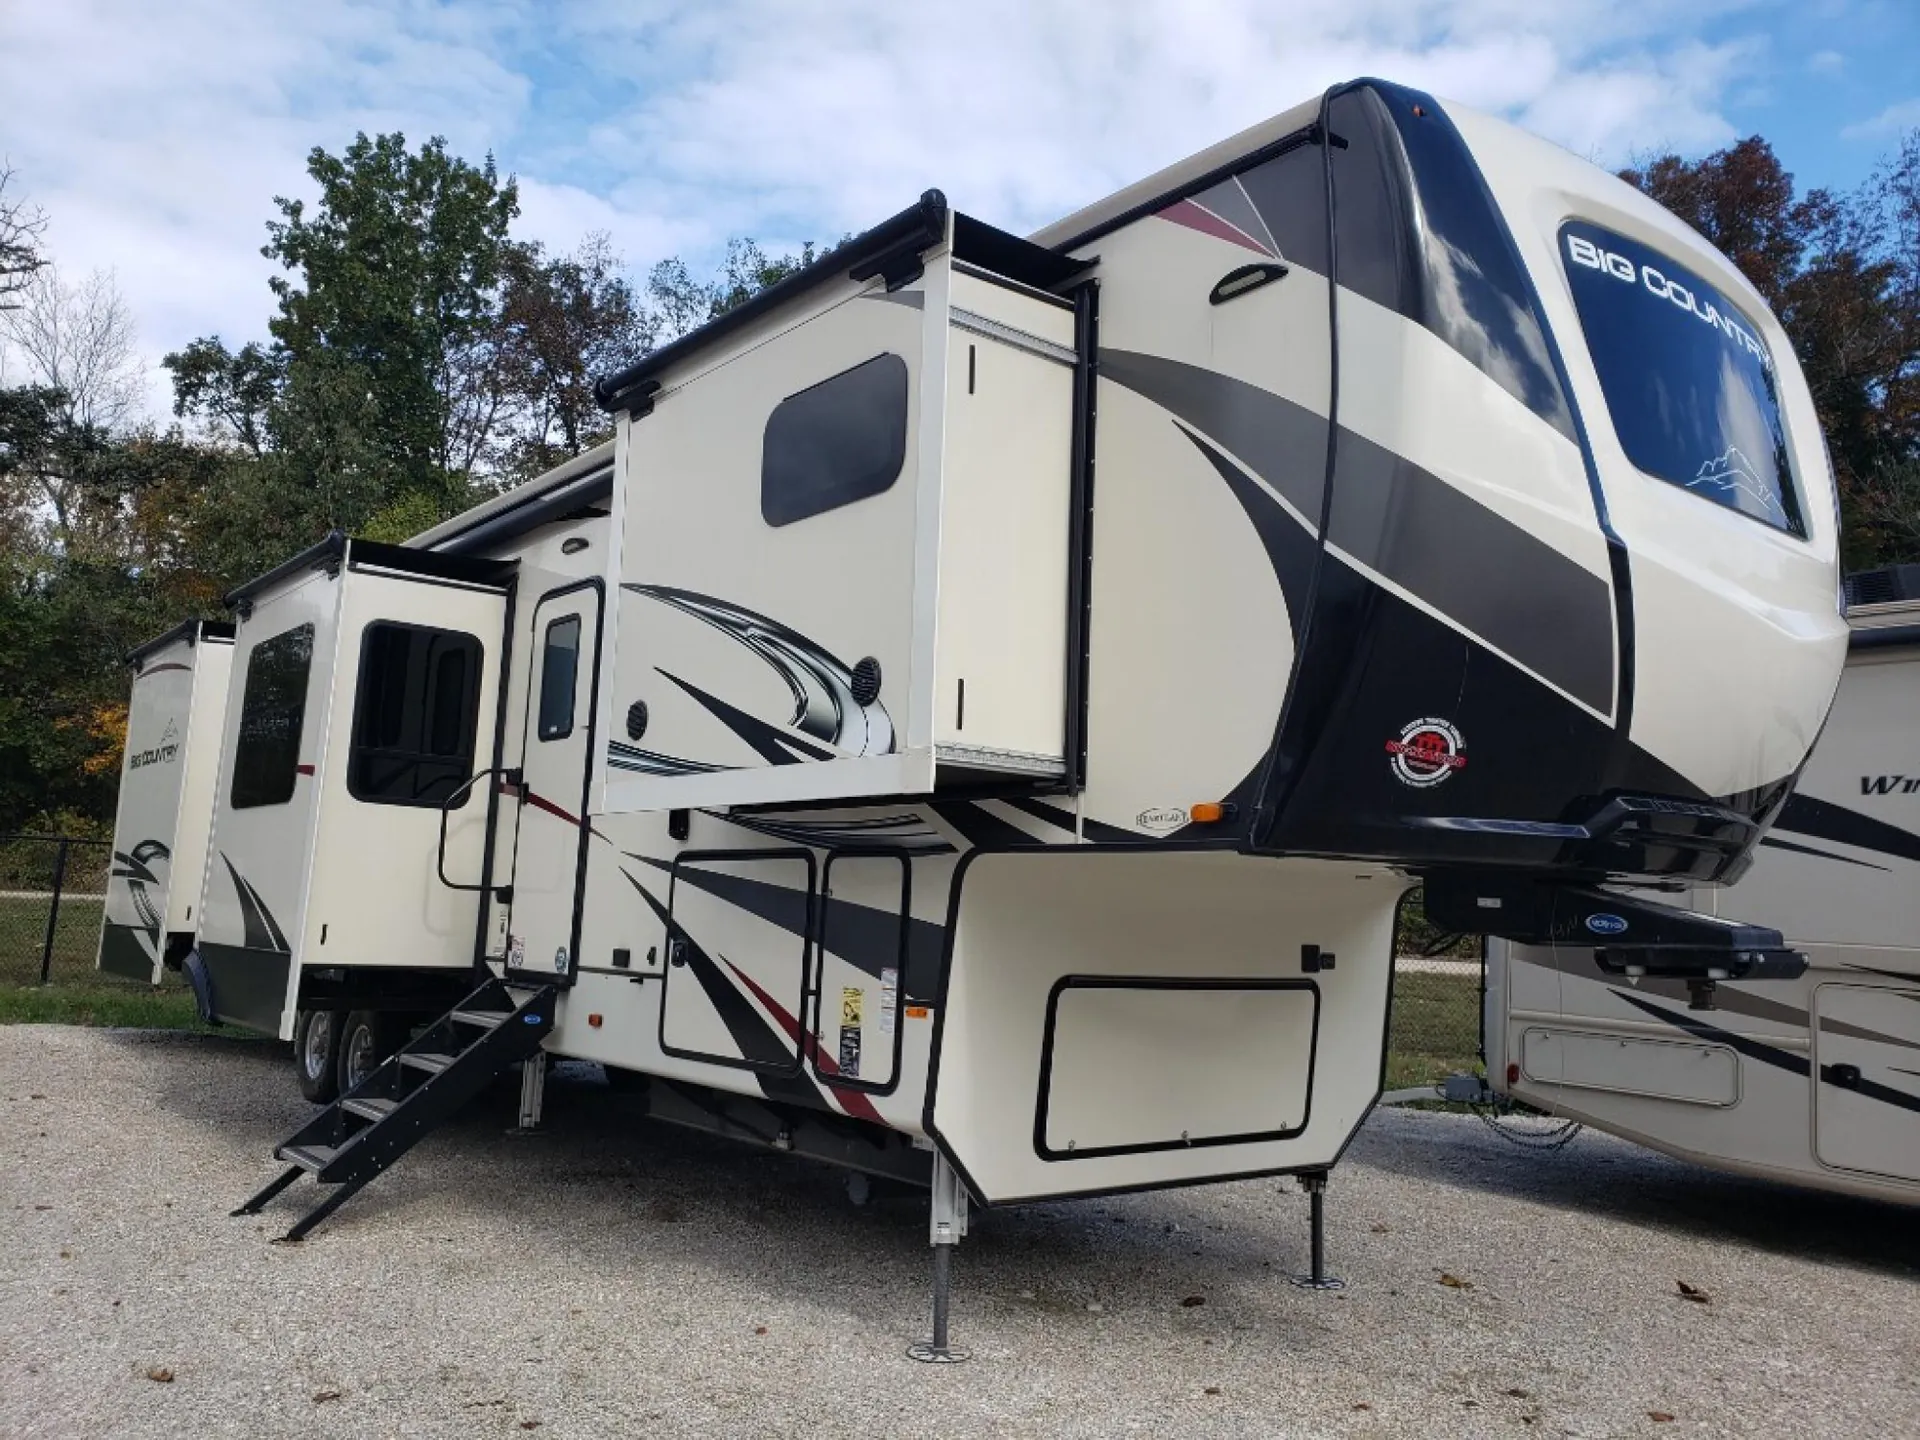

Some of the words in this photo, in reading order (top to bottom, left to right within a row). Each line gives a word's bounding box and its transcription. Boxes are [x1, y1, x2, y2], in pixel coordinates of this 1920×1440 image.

[1567, 233, 1636, 283] BIG
[1641, 265, 1774, 371] COUNTRY
[130, 753, 141, 770] BIG
[142, 743, 180, 767] COUNTRY
